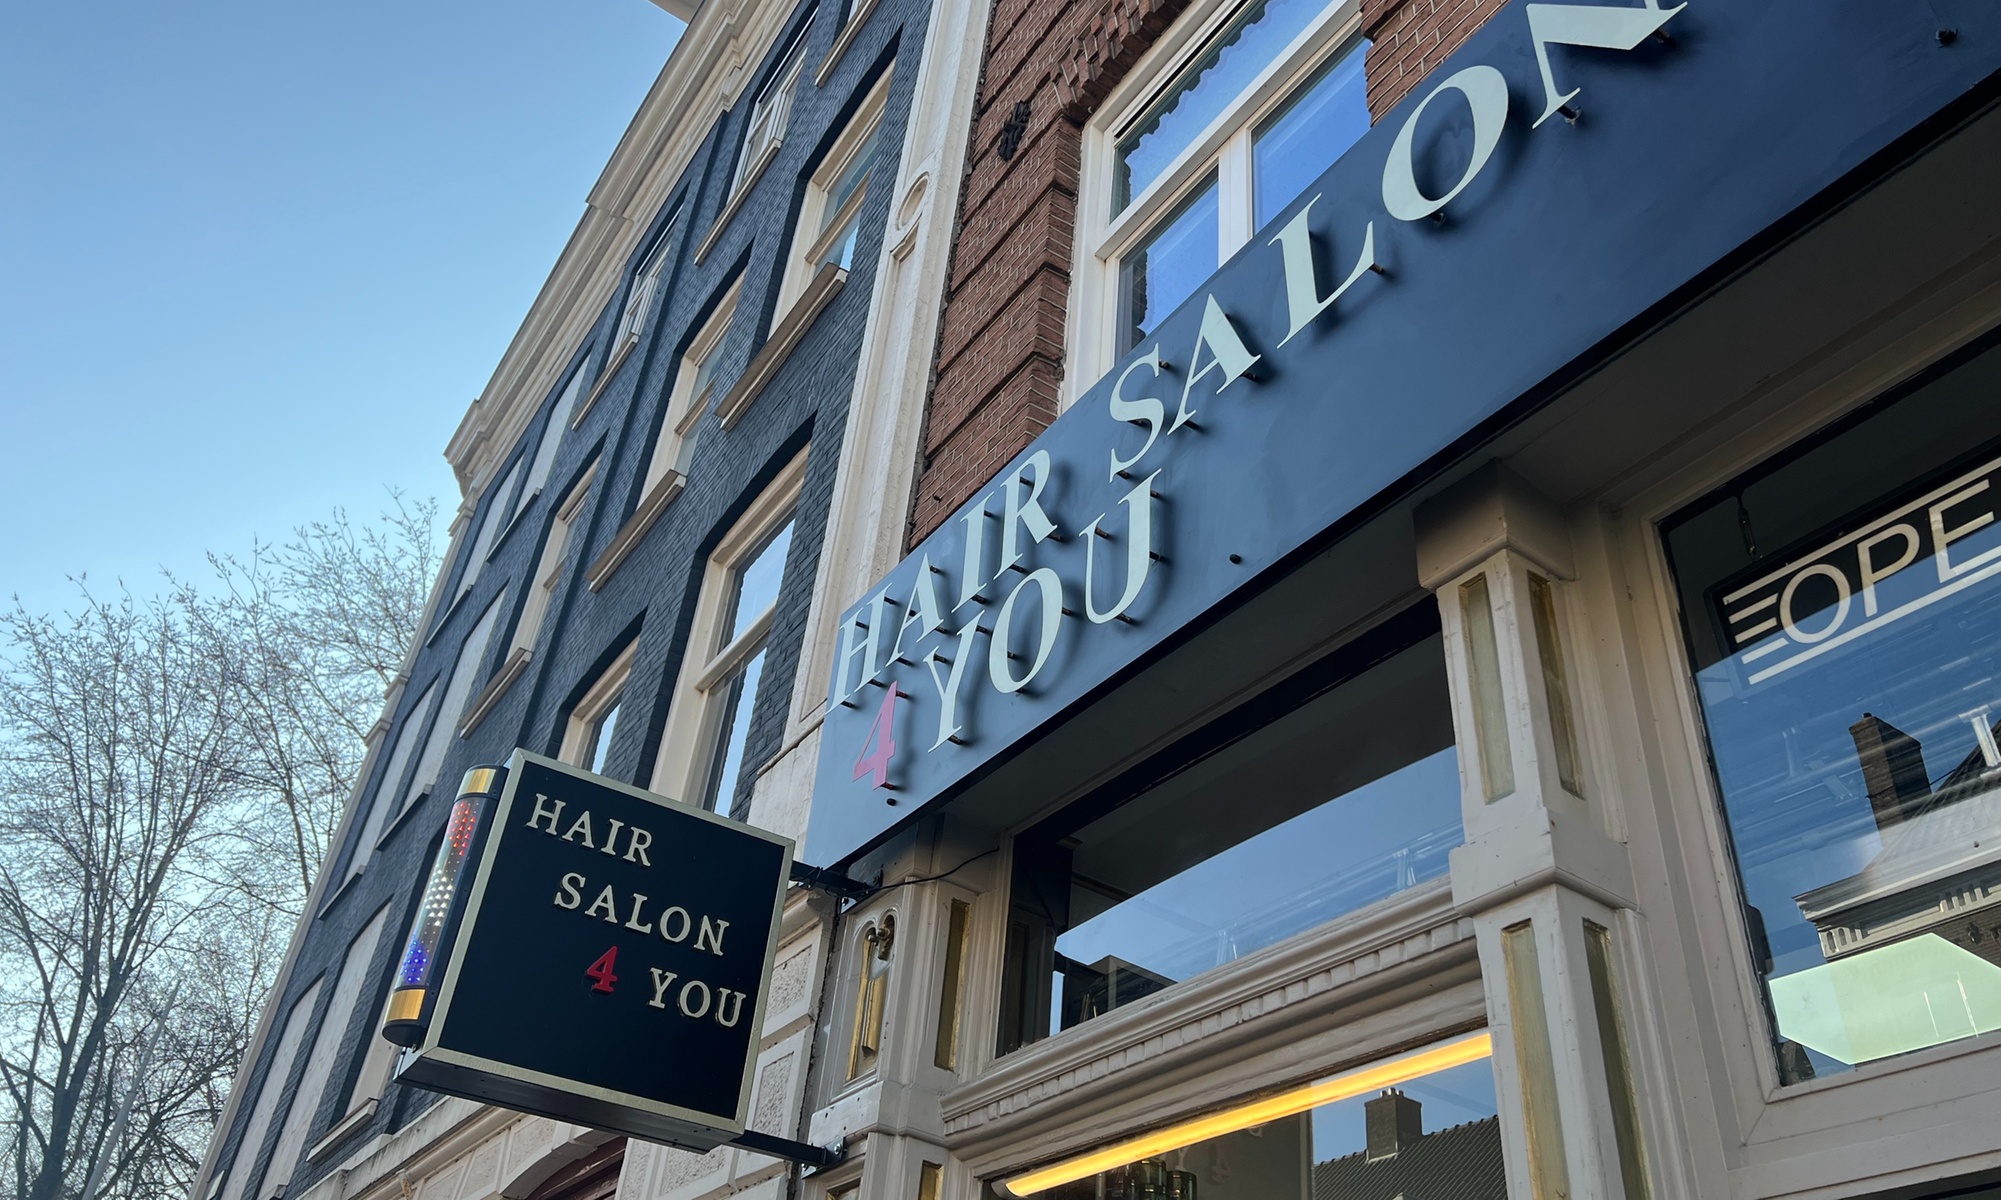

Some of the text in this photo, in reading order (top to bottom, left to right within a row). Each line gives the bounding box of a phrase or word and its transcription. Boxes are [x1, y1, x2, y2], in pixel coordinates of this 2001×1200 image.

[826, 0, 1688, 714] HAIR SALON
[852, 469, 1162, 790] 4 YOU
[526, 793, 652, 866] HAIR
[554, 872, 730, 956] SALON
[585, 945, 746, 1028] 4 YOU
